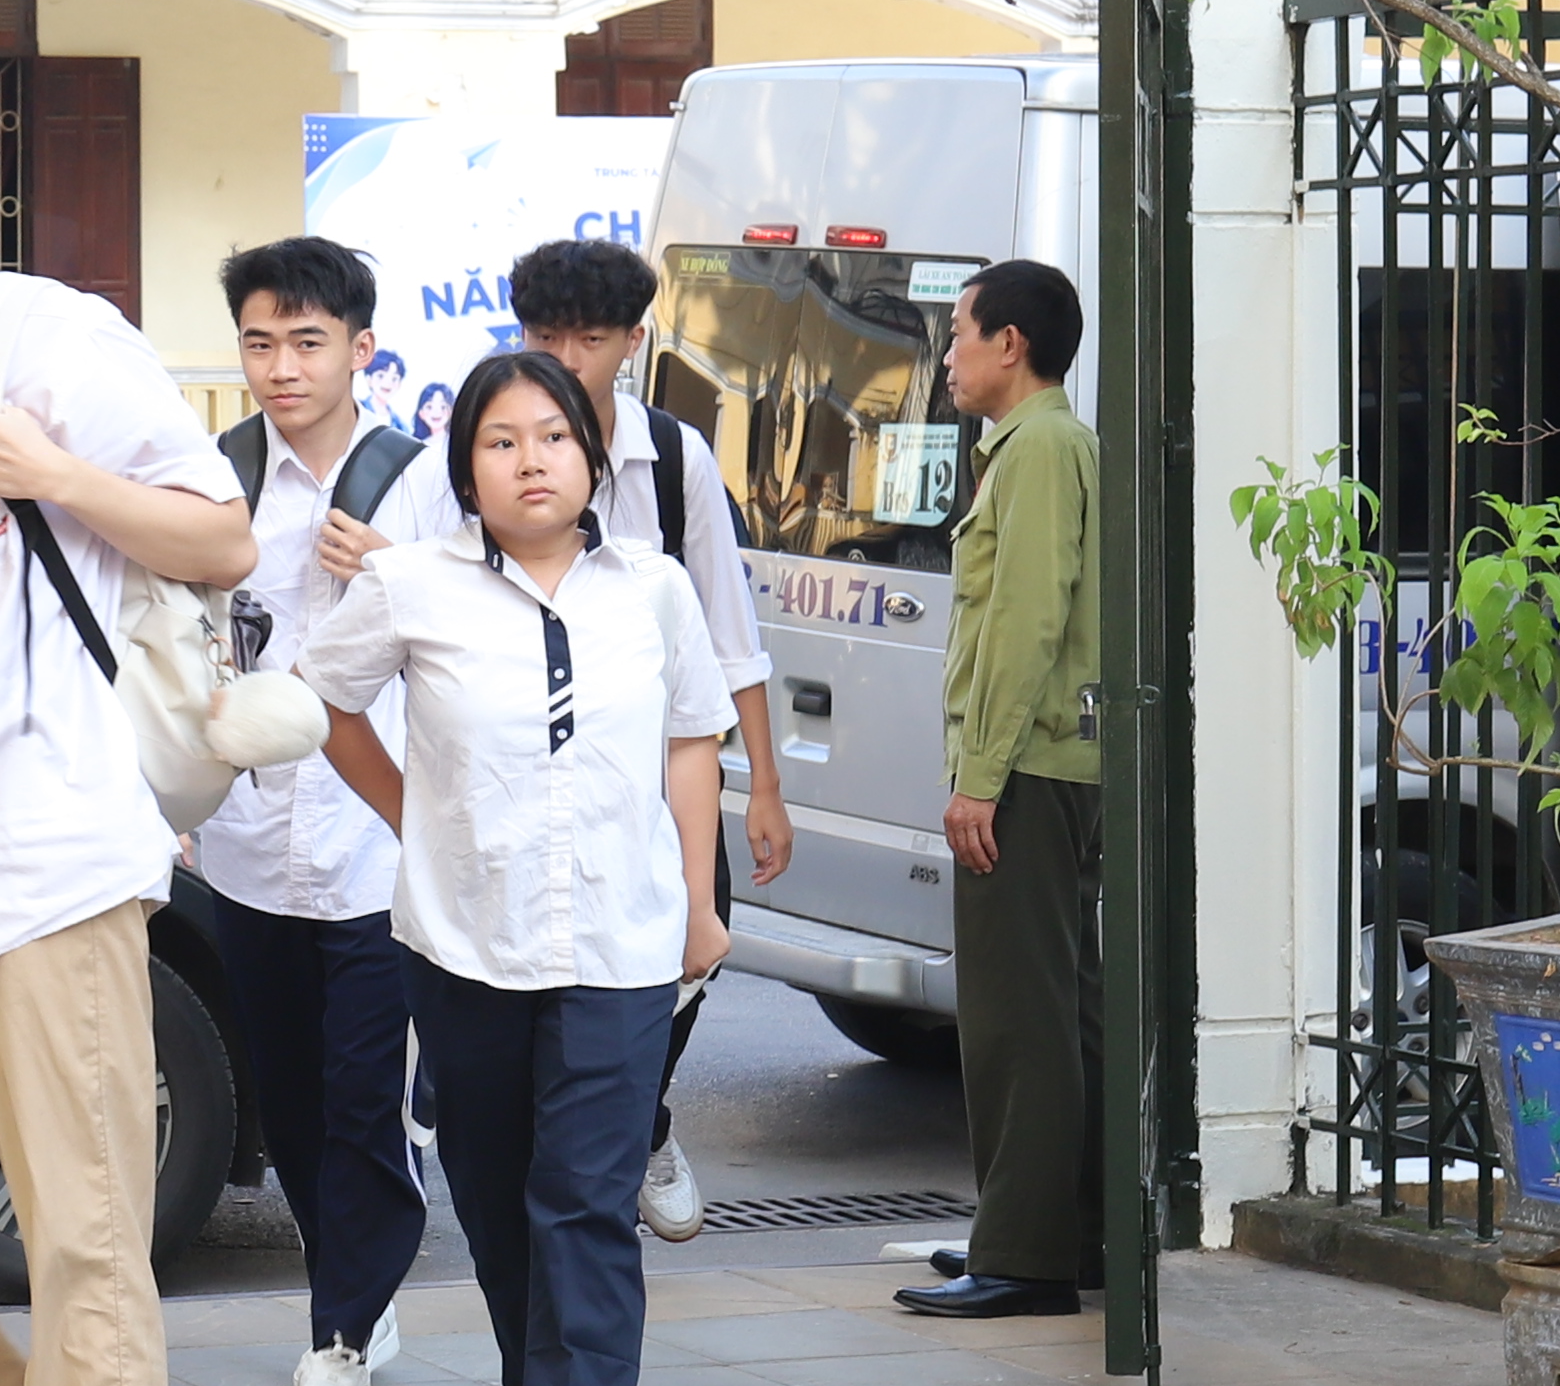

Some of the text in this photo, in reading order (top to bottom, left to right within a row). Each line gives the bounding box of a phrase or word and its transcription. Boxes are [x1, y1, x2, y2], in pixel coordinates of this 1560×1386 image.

[594, 166, 660, 178] TRUNG TÂ
[915, 459, 953, 514] 12
[910, 864, 939, 884] ABS
